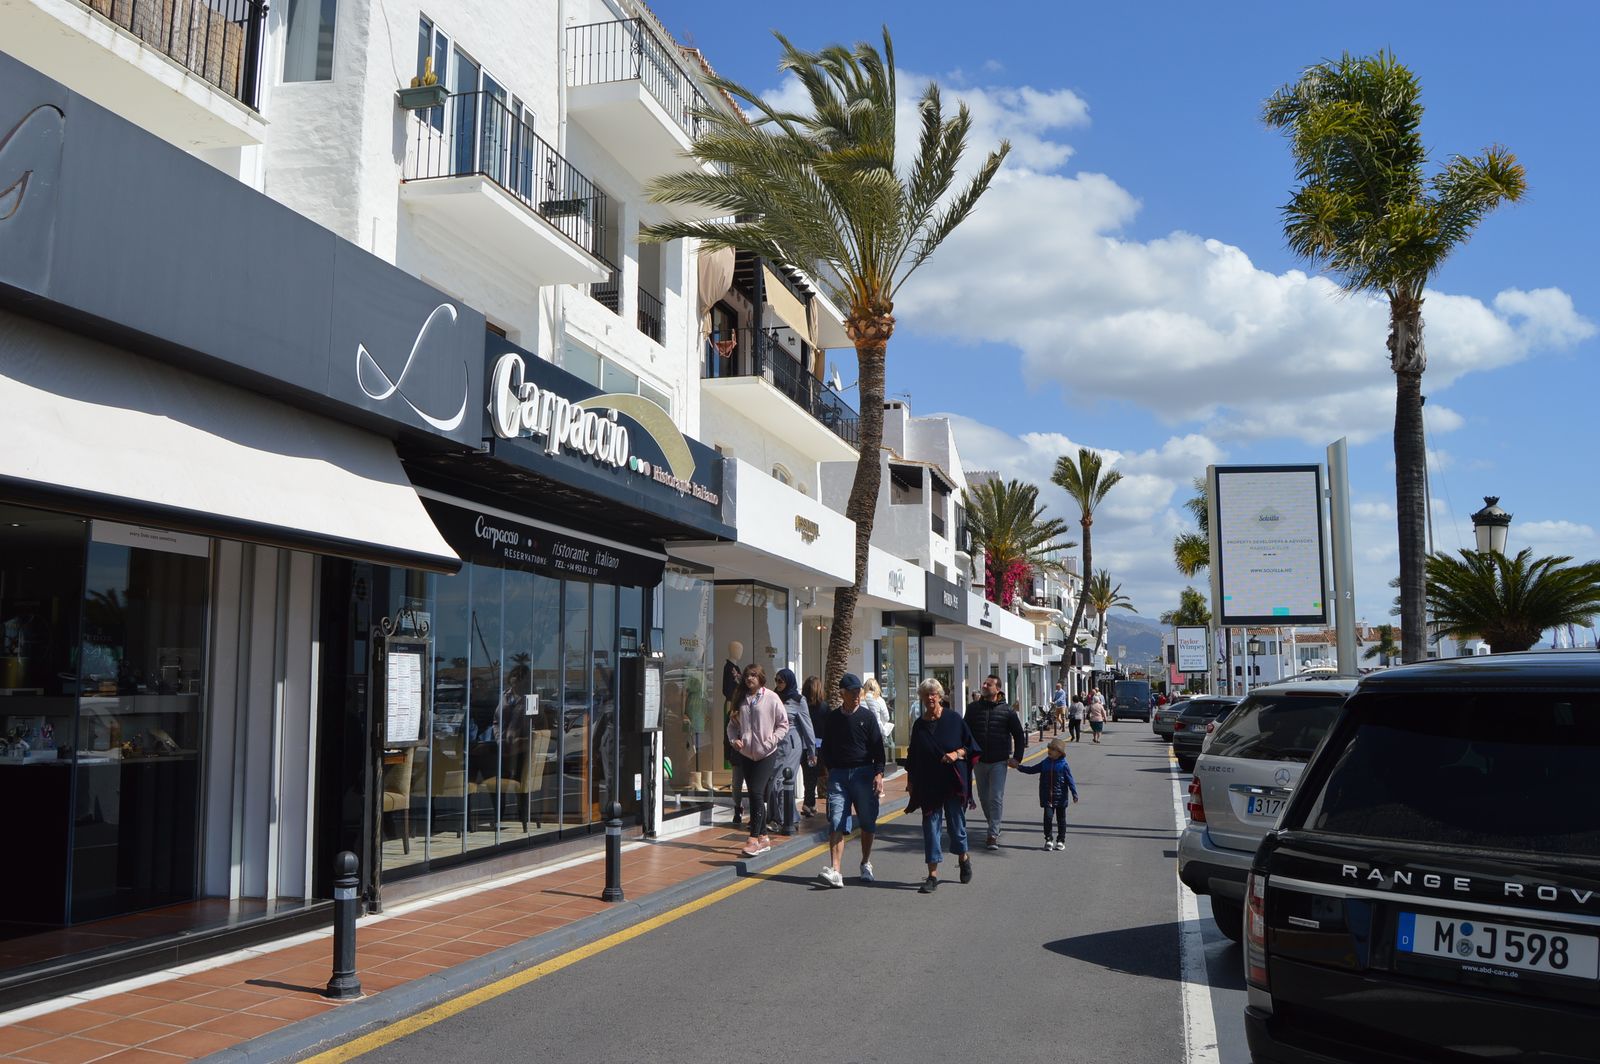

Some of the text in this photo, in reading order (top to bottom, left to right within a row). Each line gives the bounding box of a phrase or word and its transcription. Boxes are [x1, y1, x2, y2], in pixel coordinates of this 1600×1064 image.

[488, 353, 629, 468] Carpaccio
[653, 464, 719, 505] Ristorante Italiano
[475, 515, 620, 569] Carpaccio ristorante italiano
[504, 548, 547, 565] RESERVATIONS
[1179, 643, 1205, 651] Wimpey
[1255, 799, 1285, 814] 317
[1342, 864, 1593, 904] RANGE ROV
[1402, 935, 1409, 945] D
[1461, 964, 1519, 978] www.abd-cars.de
